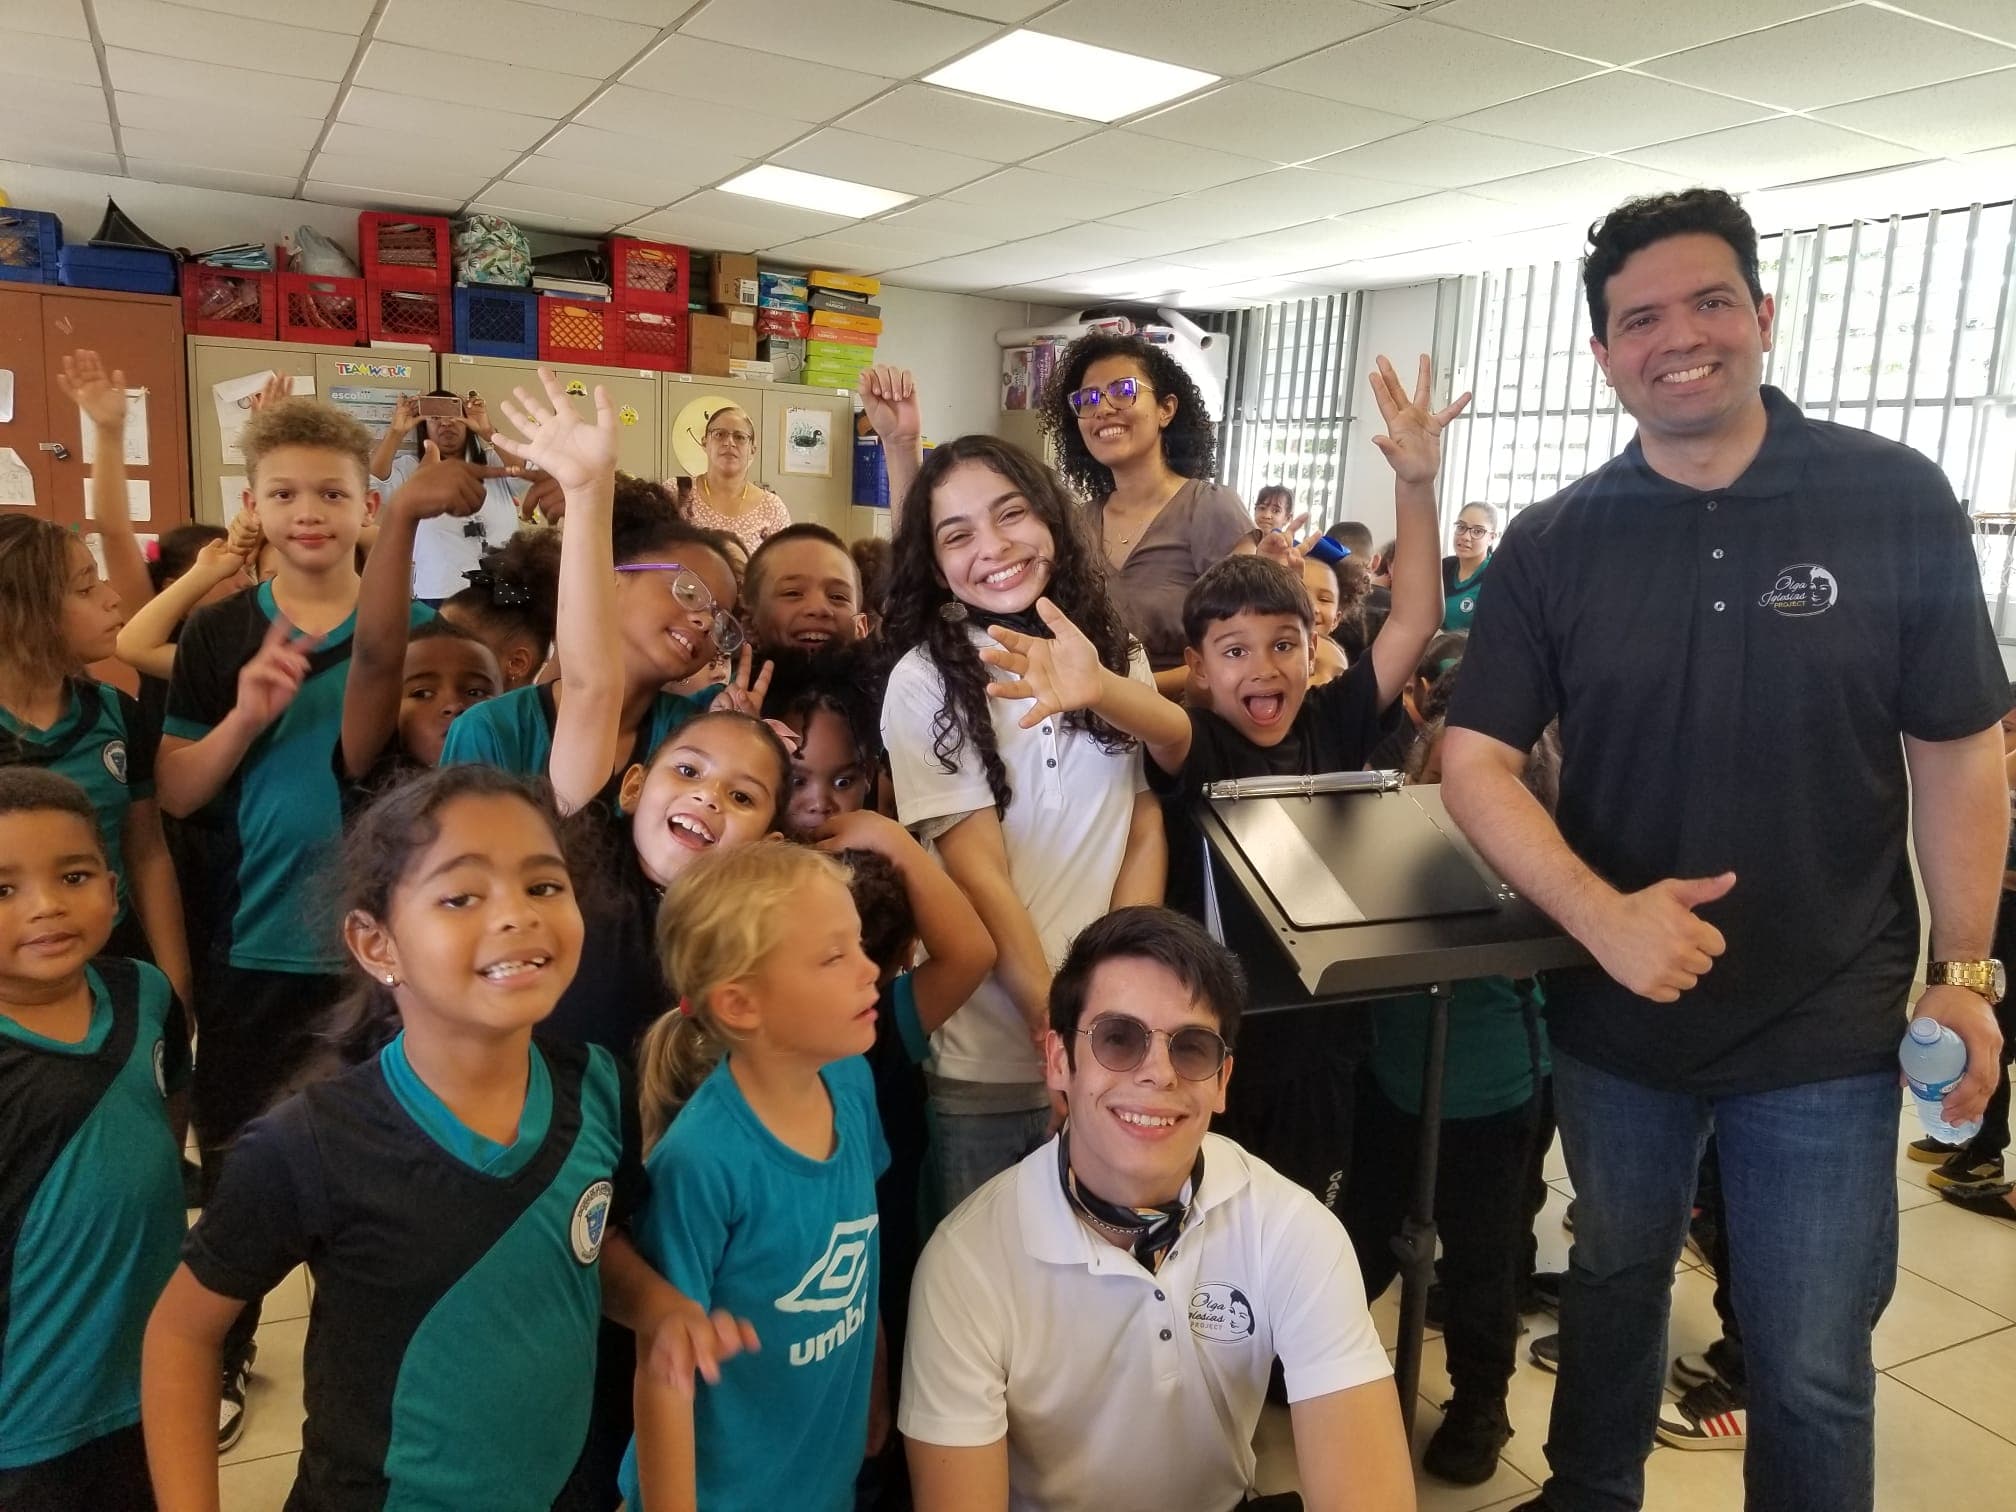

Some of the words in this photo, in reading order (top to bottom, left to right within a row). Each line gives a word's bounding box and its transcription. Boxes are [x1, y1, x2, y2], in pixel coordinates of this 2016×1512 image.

[1775, 576, 1807, 592] Olga
[1758, 589, 1808, 607] Iglesias
[1191, 1292, 1226, 1312] Olga
[1188, 1311, 1226, 1323] lesias
[1190, 1321, 1223, 1331] PROJECT
